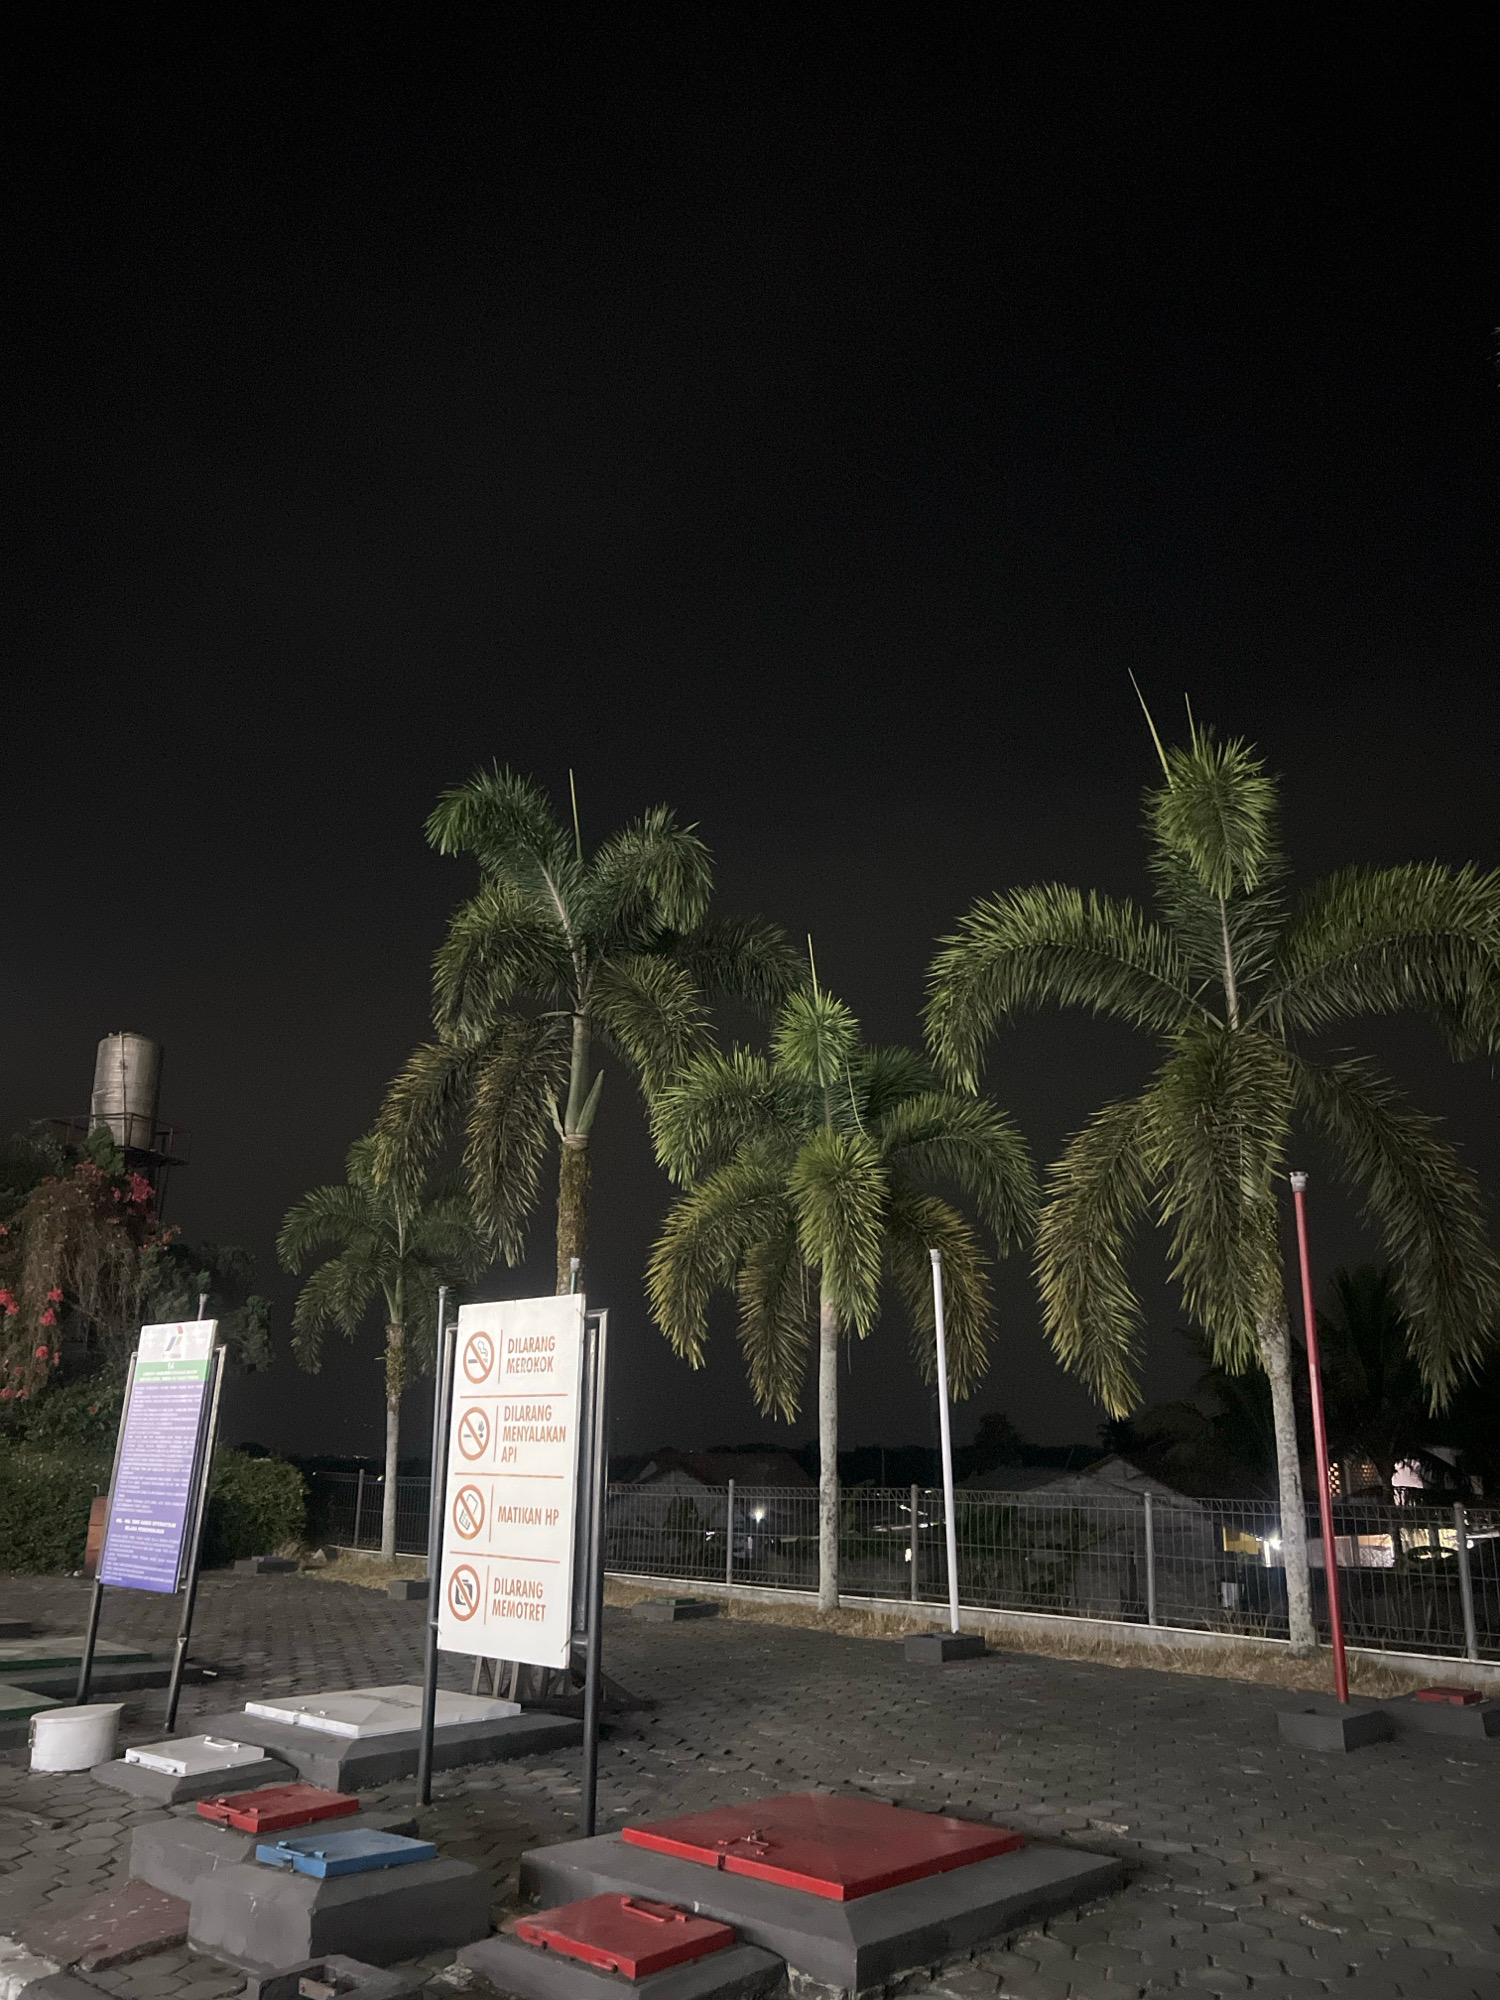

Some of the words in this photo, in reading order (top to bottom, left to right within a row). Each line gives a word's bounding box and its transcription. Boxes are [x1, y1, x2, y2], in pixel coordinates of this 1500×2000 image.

[507, 1336, 556, 1354] DILARANG
[506, 1356, 555, 1374] MEROKOK
[503, 1405, 553, 1422] DILARANG
[502, 1425, 567, 1444] MENYALAKAN
[501, 1446, 518, 1463] API
[497, 1505, 542, 1524] MATIKAN
[545, 1508, 560, 1526] HP
[493, 1577, 543, 1600] DILARANG
[491, 1599, 547, 1622] MEMOTRET
